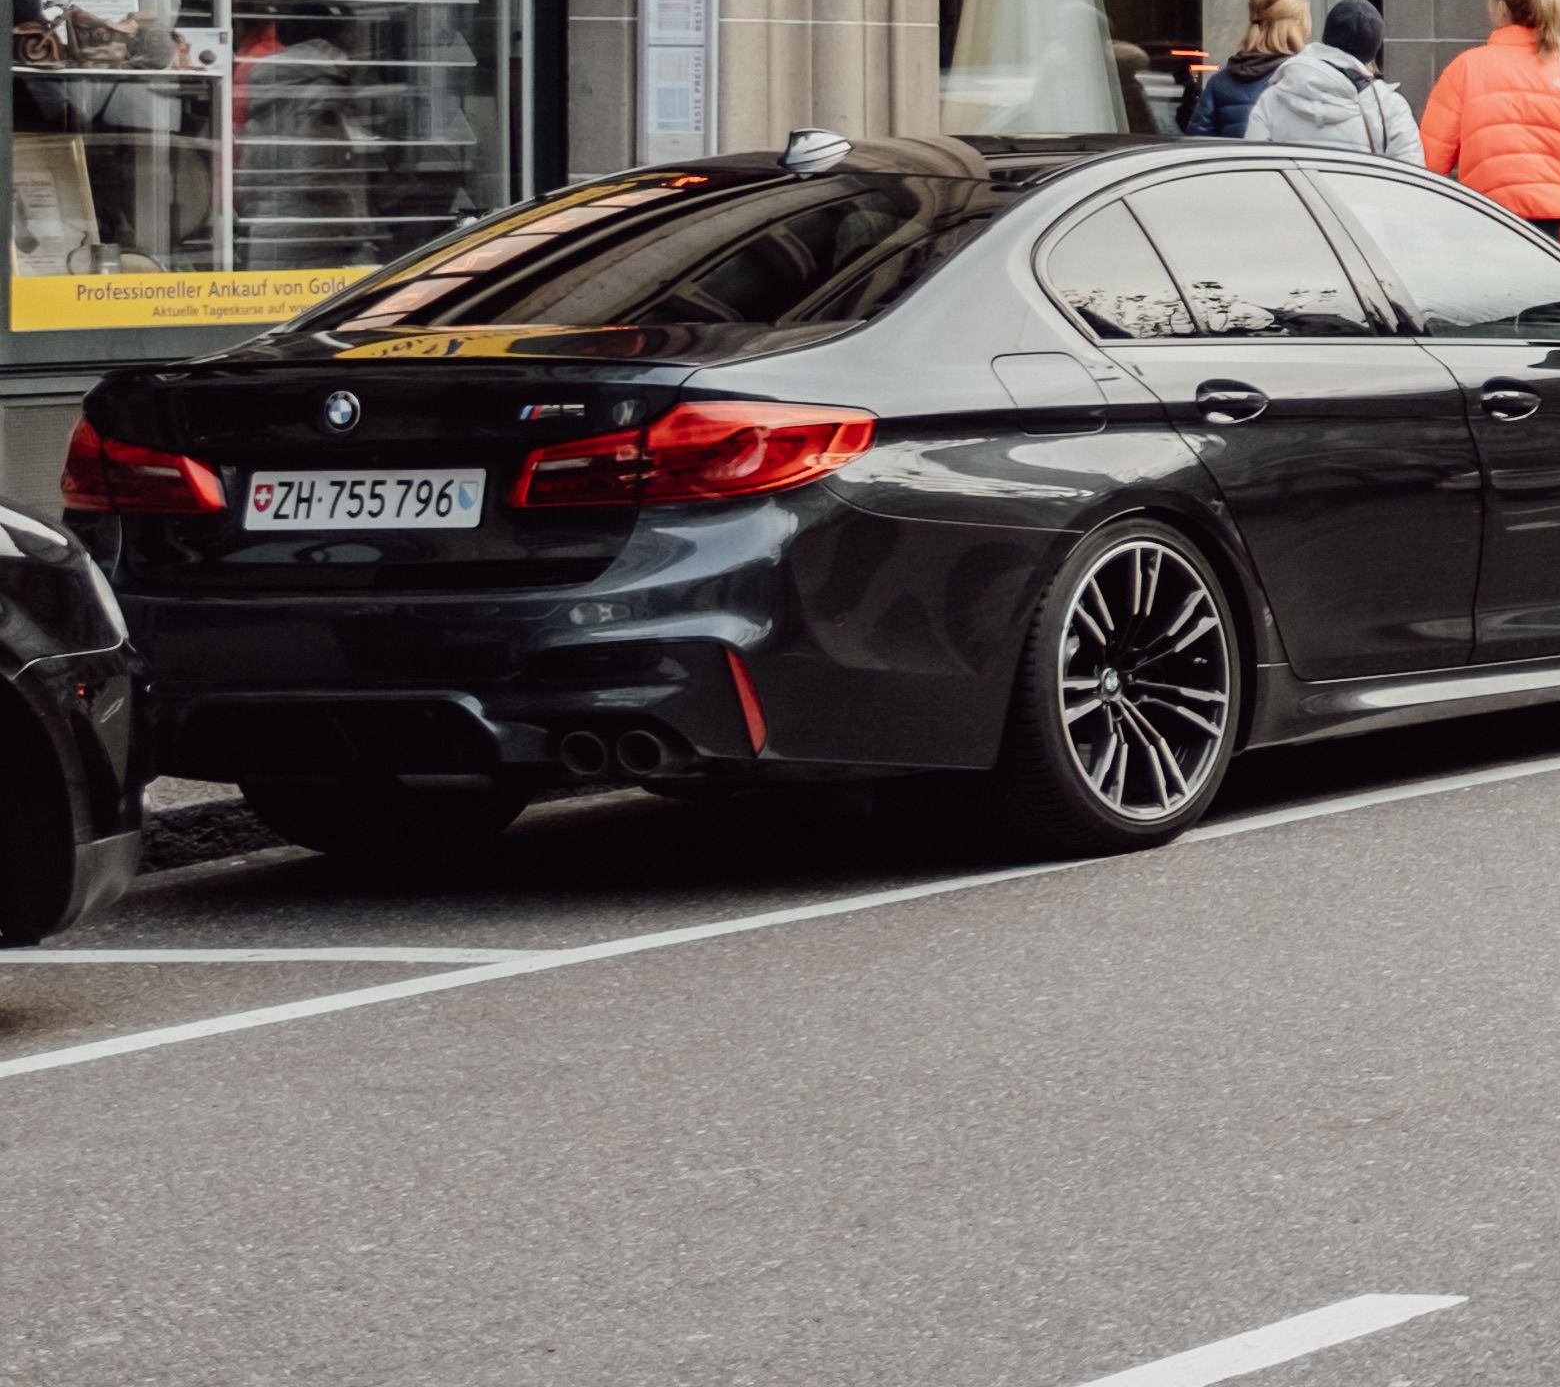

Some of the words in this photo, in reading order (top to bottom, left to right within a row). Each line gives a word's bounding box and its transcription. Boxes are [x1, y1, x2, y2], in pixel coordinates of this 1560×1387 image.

[76, 280, 201, 301] Professioneller
[207, 278, 269, 299] Ankauf
[274, 280, 304, 297] von
[309, 276, 346, 295] Gold
[152, 304, 200, 318] Aktuelle
[202, 303, 264, 319] Tageskurse
